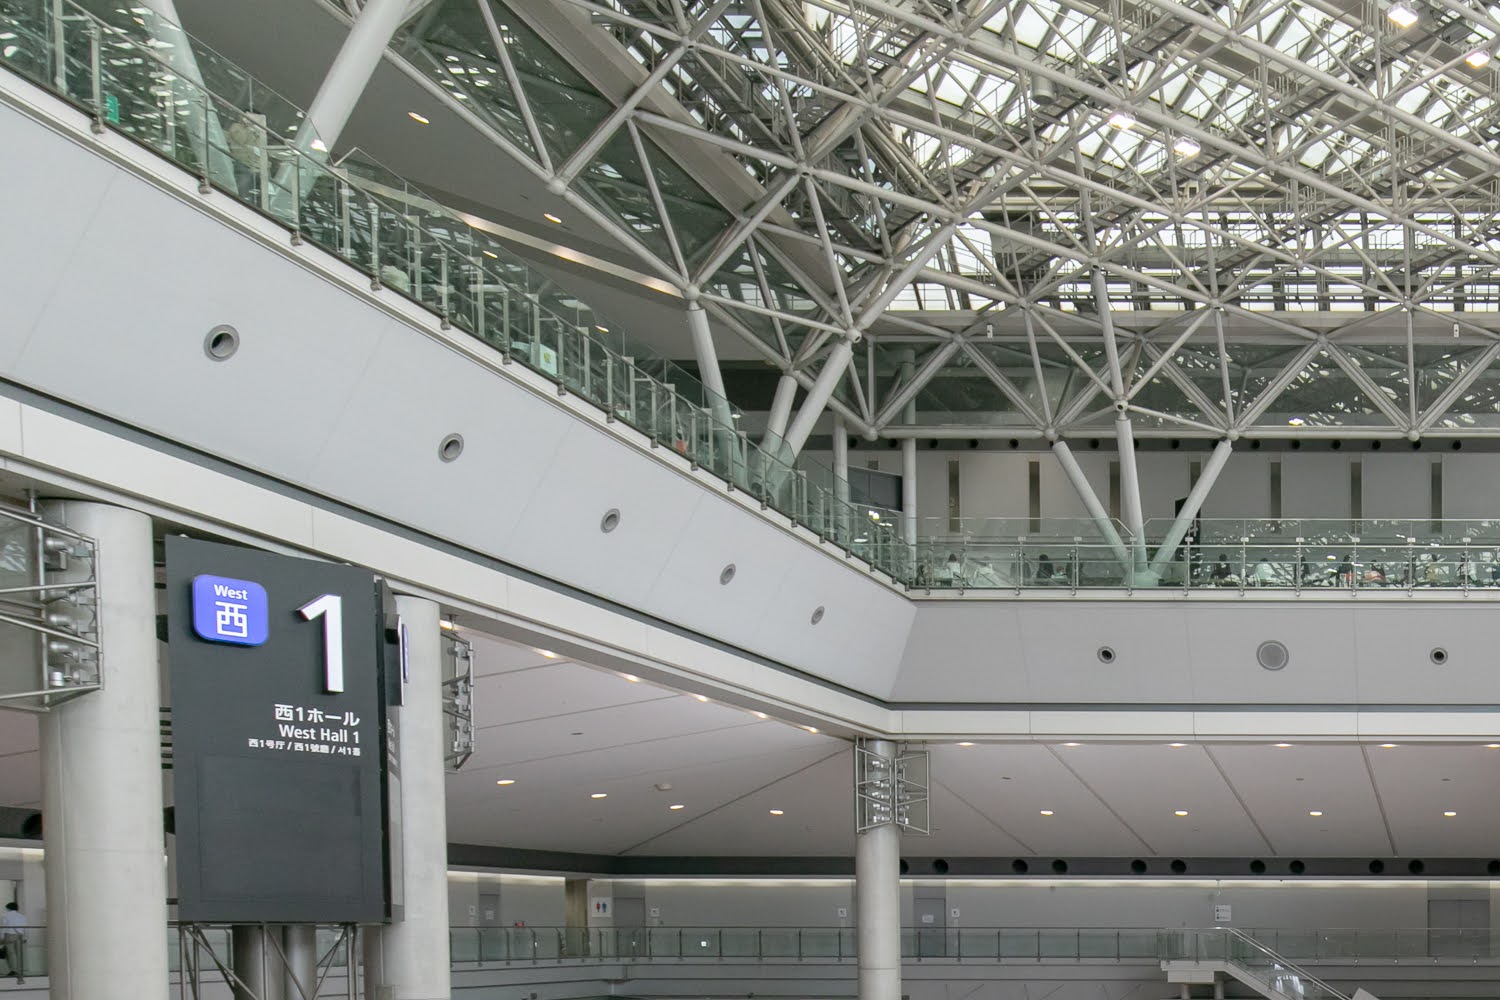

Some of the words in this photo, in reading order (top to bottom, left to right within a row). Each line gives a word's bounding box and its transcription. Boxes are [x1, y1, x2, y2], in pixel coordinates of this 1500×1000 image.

[214, 584, 248, 600] West
[215, 601, 247, 637] 西
[300, 594, 344, 692] 1
[274, 704, 360, 726] 西1ホール
[279, 724, 316, 740] West
[320, 728, 347, 743] Hall
[353, 731, 359, 744] 1
